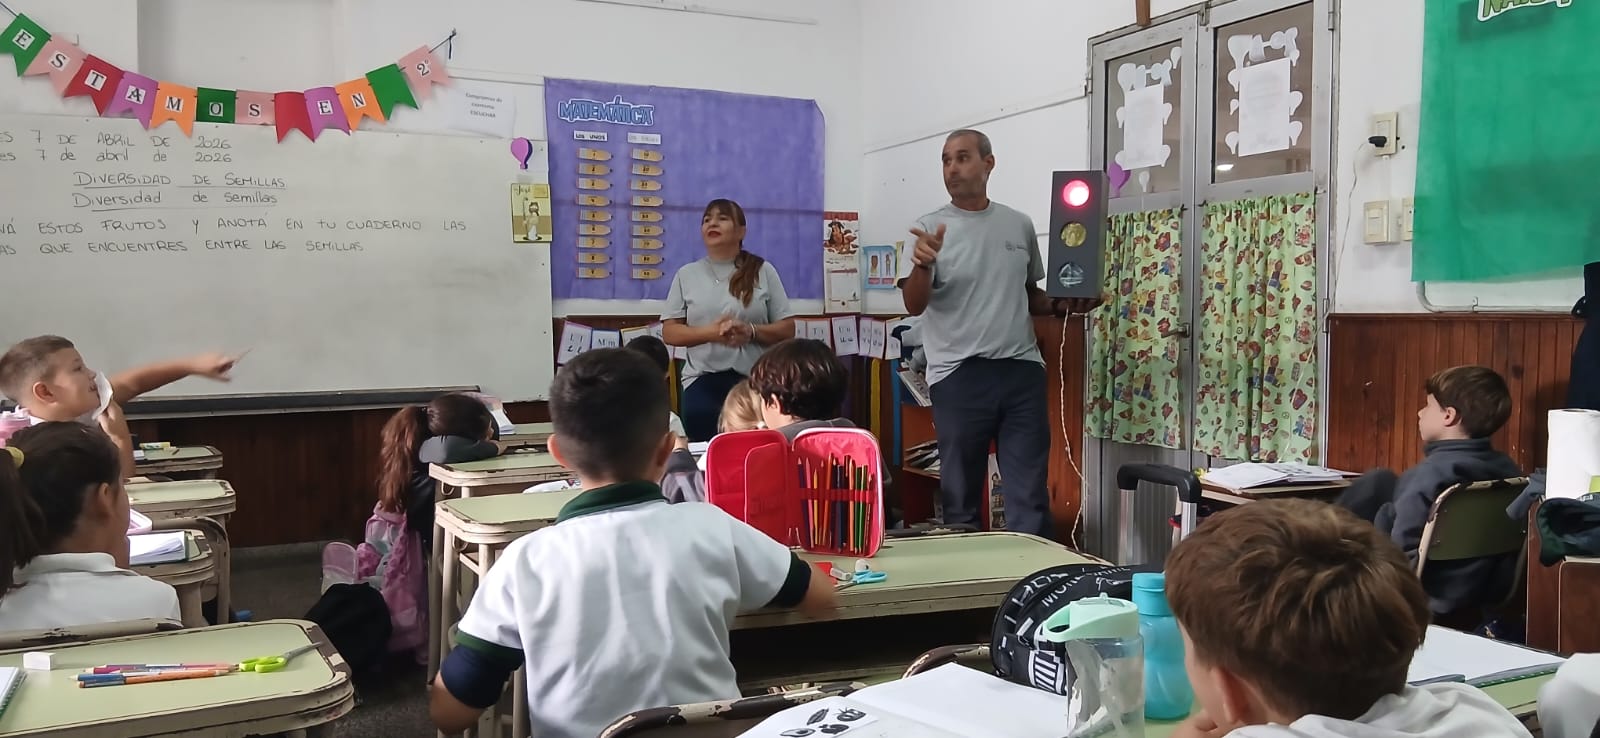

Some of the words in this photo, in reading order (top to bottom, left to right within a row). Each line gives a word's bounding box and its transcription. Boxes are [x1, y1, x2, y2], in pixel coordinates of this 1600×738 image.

[559, 95, 654, 126] MATEMÁTICA
[30, 129, 41, 144] 7
[58, 134, 78, 145] DE
[151, 135, 171, 148] DE
[195, 135, 232, 149] 2026
[35, 149, 47, 161] 7
[60, 148, 76, 161] de
[96, 148, 129, 162] abril
[153, 150, 167, 162] de
[195, 151, 232, 163] 2026
[192, 174, 211, 185] DE
[72, 191, 162, 208] Diversidad
[192, 190, 208, 203] de
[38, 221, 84, 235] ESTOS
[101, 218, 167, 231] FRUTOS
[286, 218, 303, 230] EN
[346, 219, 422, 231] CUADERNO
[443, 219, 467, 232] LAS
[39, 242, 73, 255] QUE
[88, 240, 188, 253] ENCUENTRES
[206, 239, 252, 250] ENTRE
[265, 239, 287, 250] LAS
[306, 240, 364, 252] SEMILLAS
